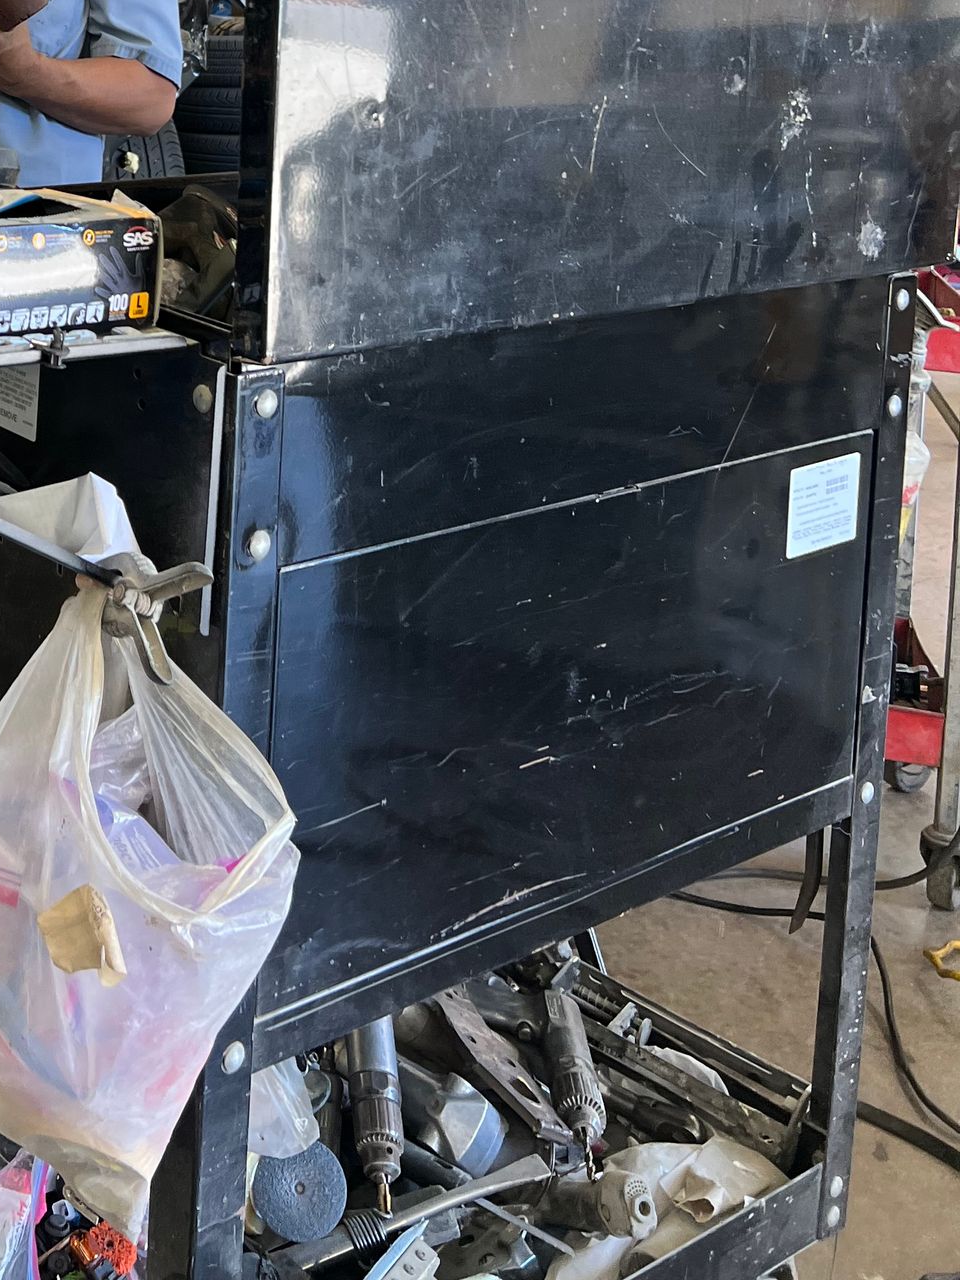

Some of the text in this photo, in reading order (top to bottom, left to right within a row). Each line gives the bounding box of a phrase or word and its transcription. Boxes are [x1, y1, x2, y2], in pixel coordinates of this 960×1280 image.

[123, 231, 154, 248] SAS
[108, 293, 129, 311] 100
[136, 296, 142, 309] L
